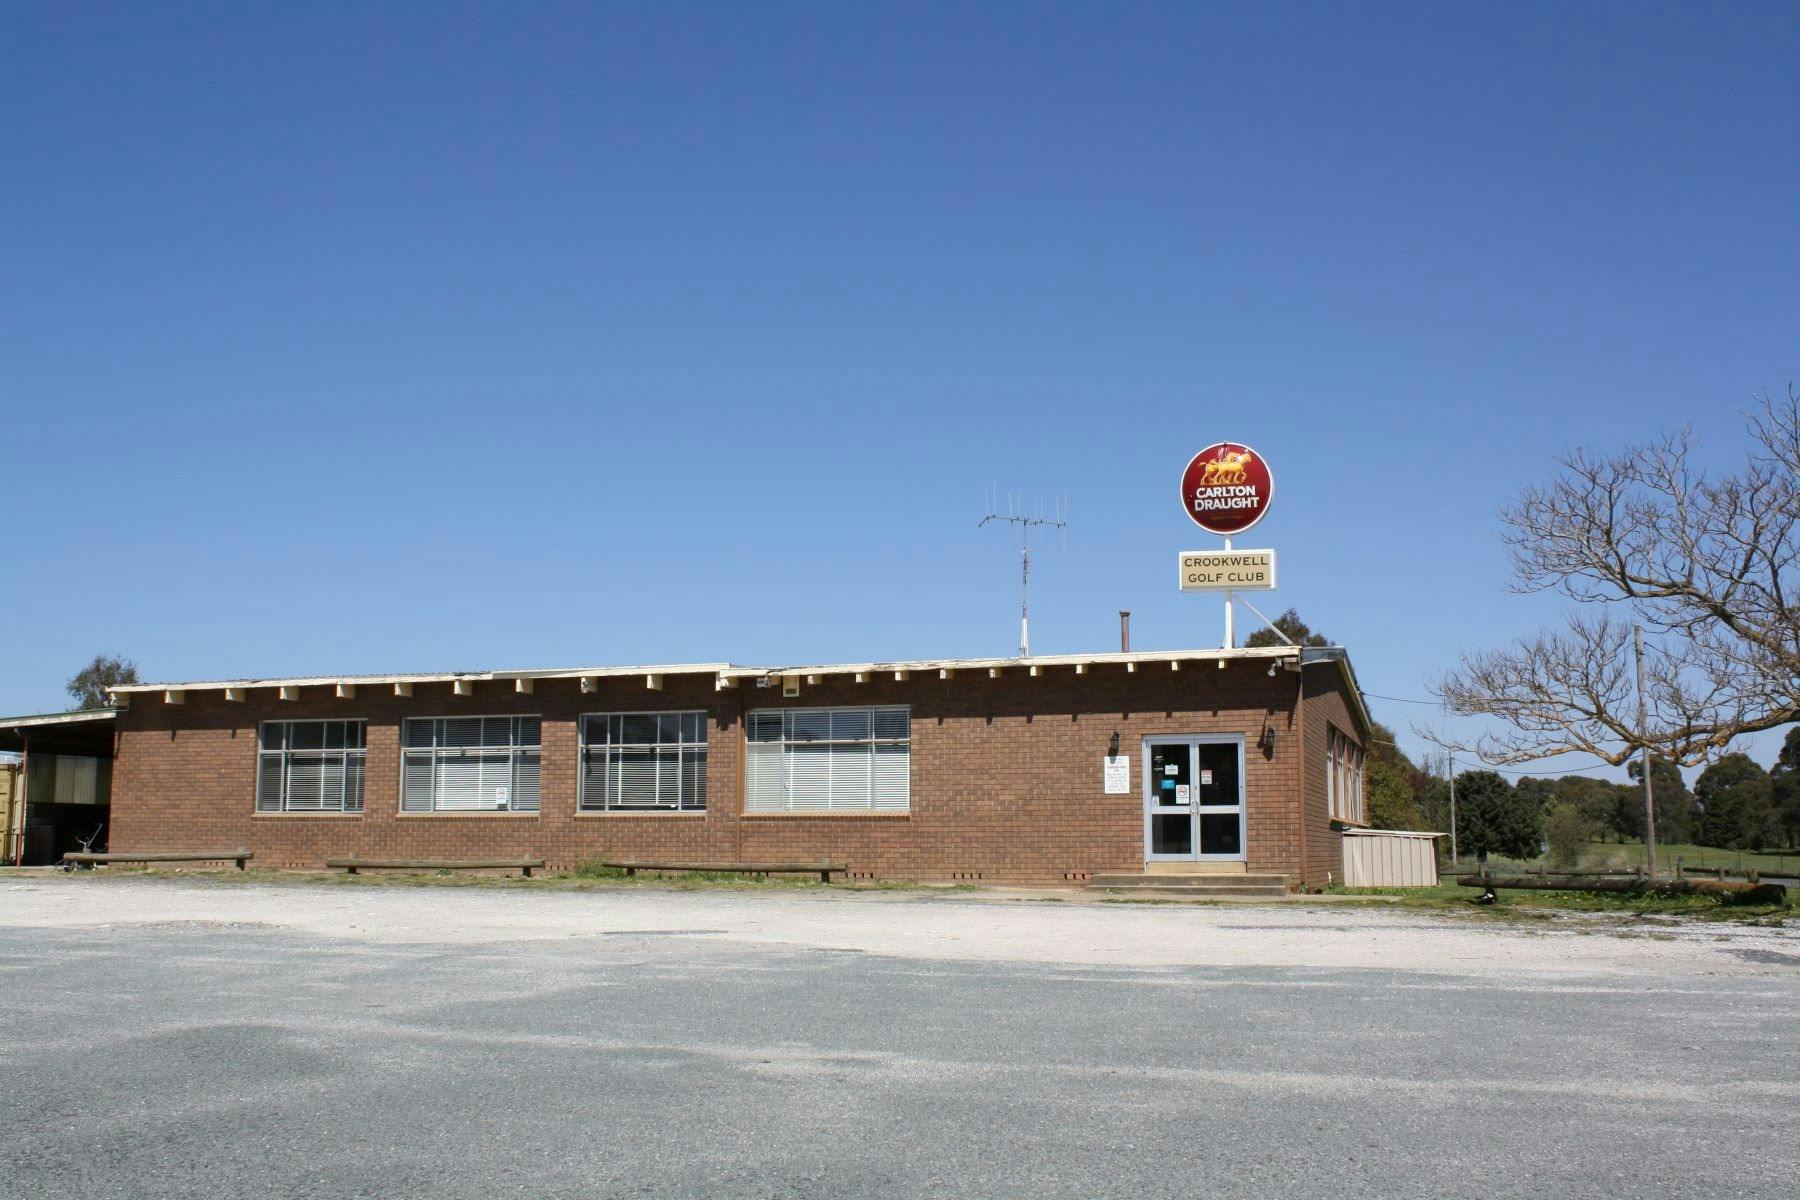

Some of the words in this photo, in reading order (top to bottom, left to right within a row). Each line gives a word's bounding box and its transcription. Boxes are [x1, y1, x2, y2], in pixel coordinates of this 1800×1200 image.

[1196, 485, 1256, 498] CARLTON
[1194, 497, 1259, 511] DRAUGHT
[1184, 556, 1268, 567] CROOKWELL
[1188, 573, 1223, 583] GOLF
[1227, 572, 1264, 582] CLUB
